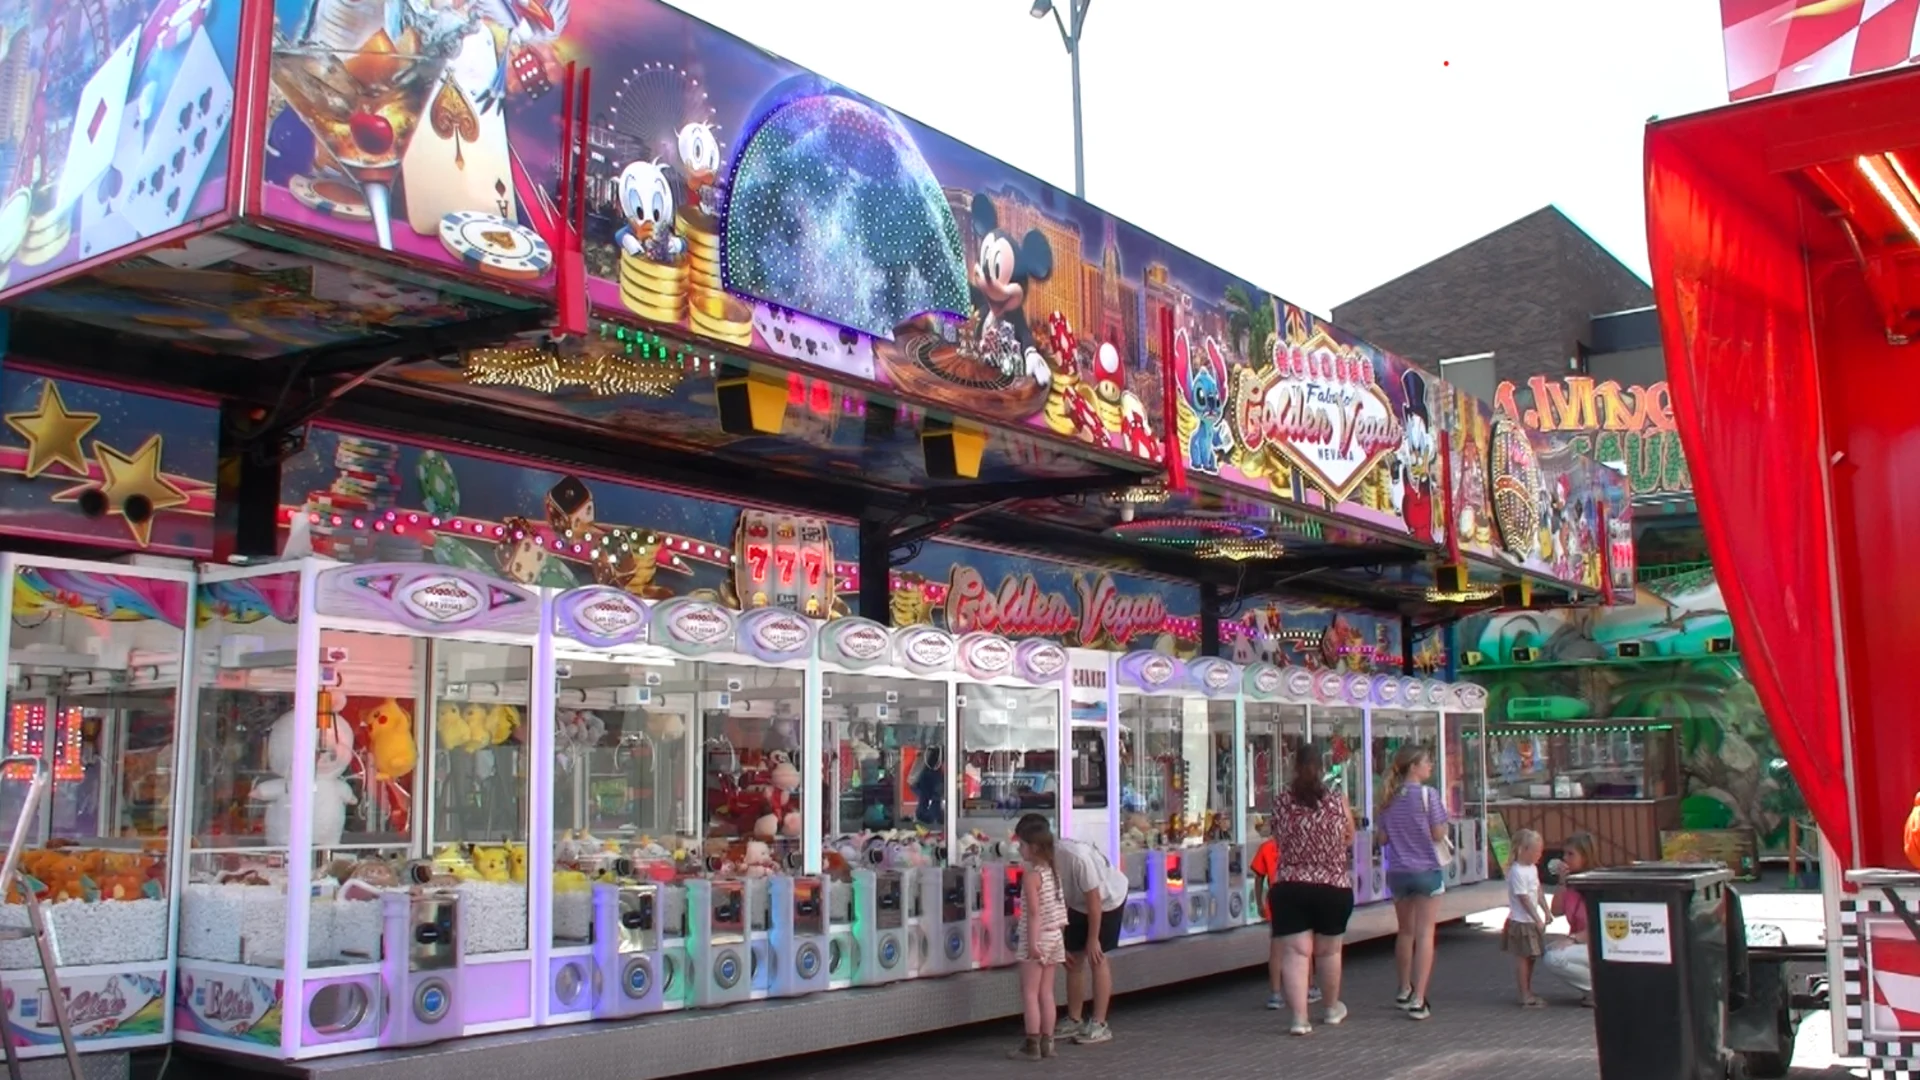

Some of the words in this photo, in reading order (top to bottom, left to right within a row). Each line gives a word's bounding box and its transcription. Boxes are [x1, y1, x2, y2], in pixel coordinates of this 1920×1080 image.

[1275, 344, 1374, 388] WELCOME
[1238, 367, 1335, 451] Golden
[1335, 393, 1404, 459] Vegas
[1317, 448, 1354, 462] NEVAA
[946, 562, 1077, 635] Golden
[1073, 570, 1167, 646] Vegas
